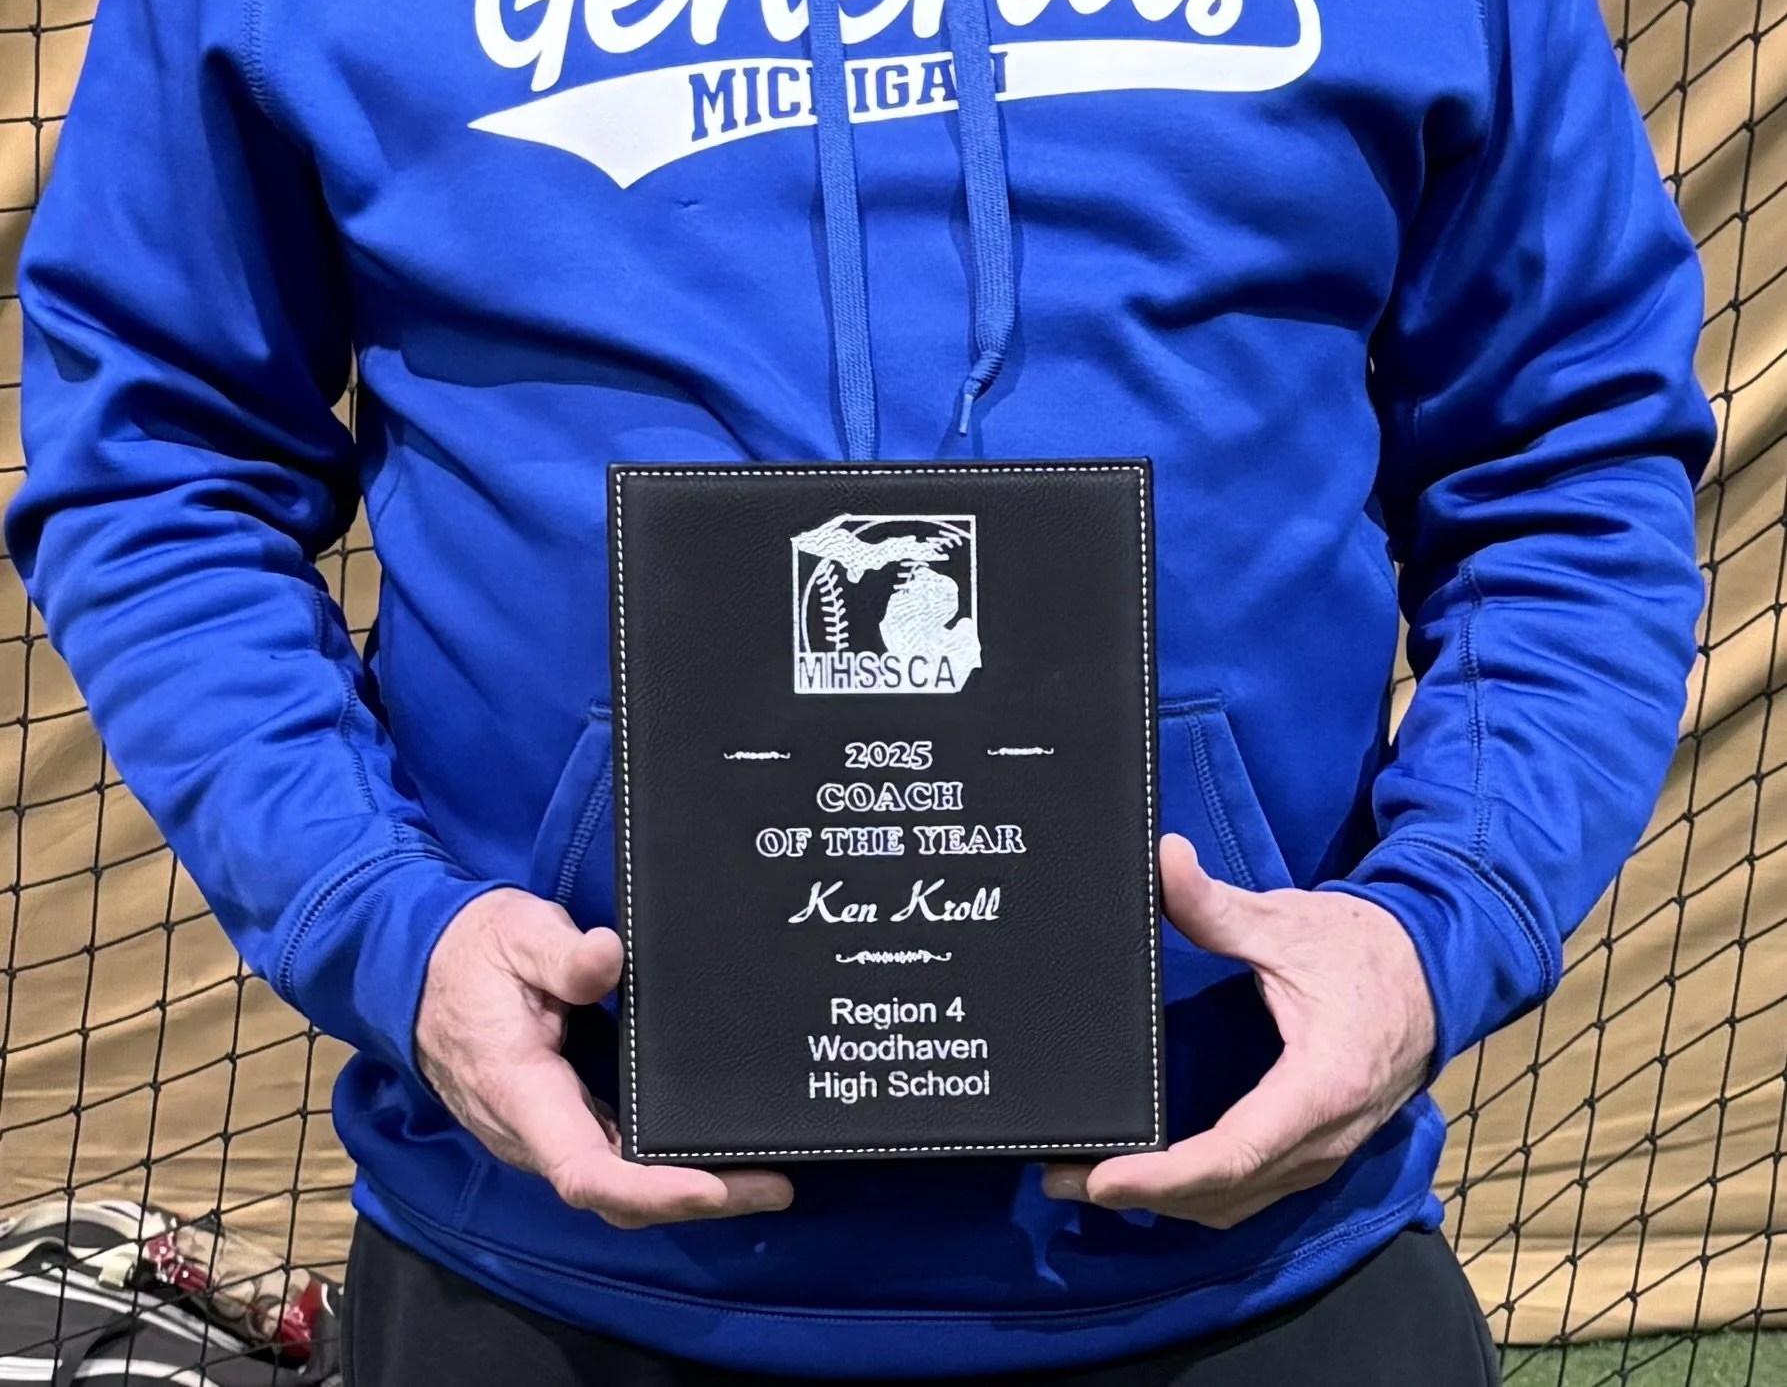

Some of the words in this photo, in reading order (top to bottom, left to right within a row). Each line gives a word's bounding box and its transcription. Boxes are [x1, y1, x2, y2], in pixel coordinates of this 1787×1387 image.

[689, 52, 1008, 142] MICIGA
[798, 654, 957, 690] MHSSCA
[845, 741, 933, 769] 2025
[816, 782, 964, 812] COACH
[755, 827, 811, 858] OF
[820, 826, 905, 856] THE
[912, 824, 1027, 854] YEAR
[788, 880, 878, 924] Ken
[890, 878, 1001, 923] Kroll
[830, 997, 936, 1029] Region
[946, 996, 965, 1023] 4
[808, 1034, 988, 1062] Woodhaven
[809, 1071, 877, 1104] High
[888, 1070, 990, 1098] School
